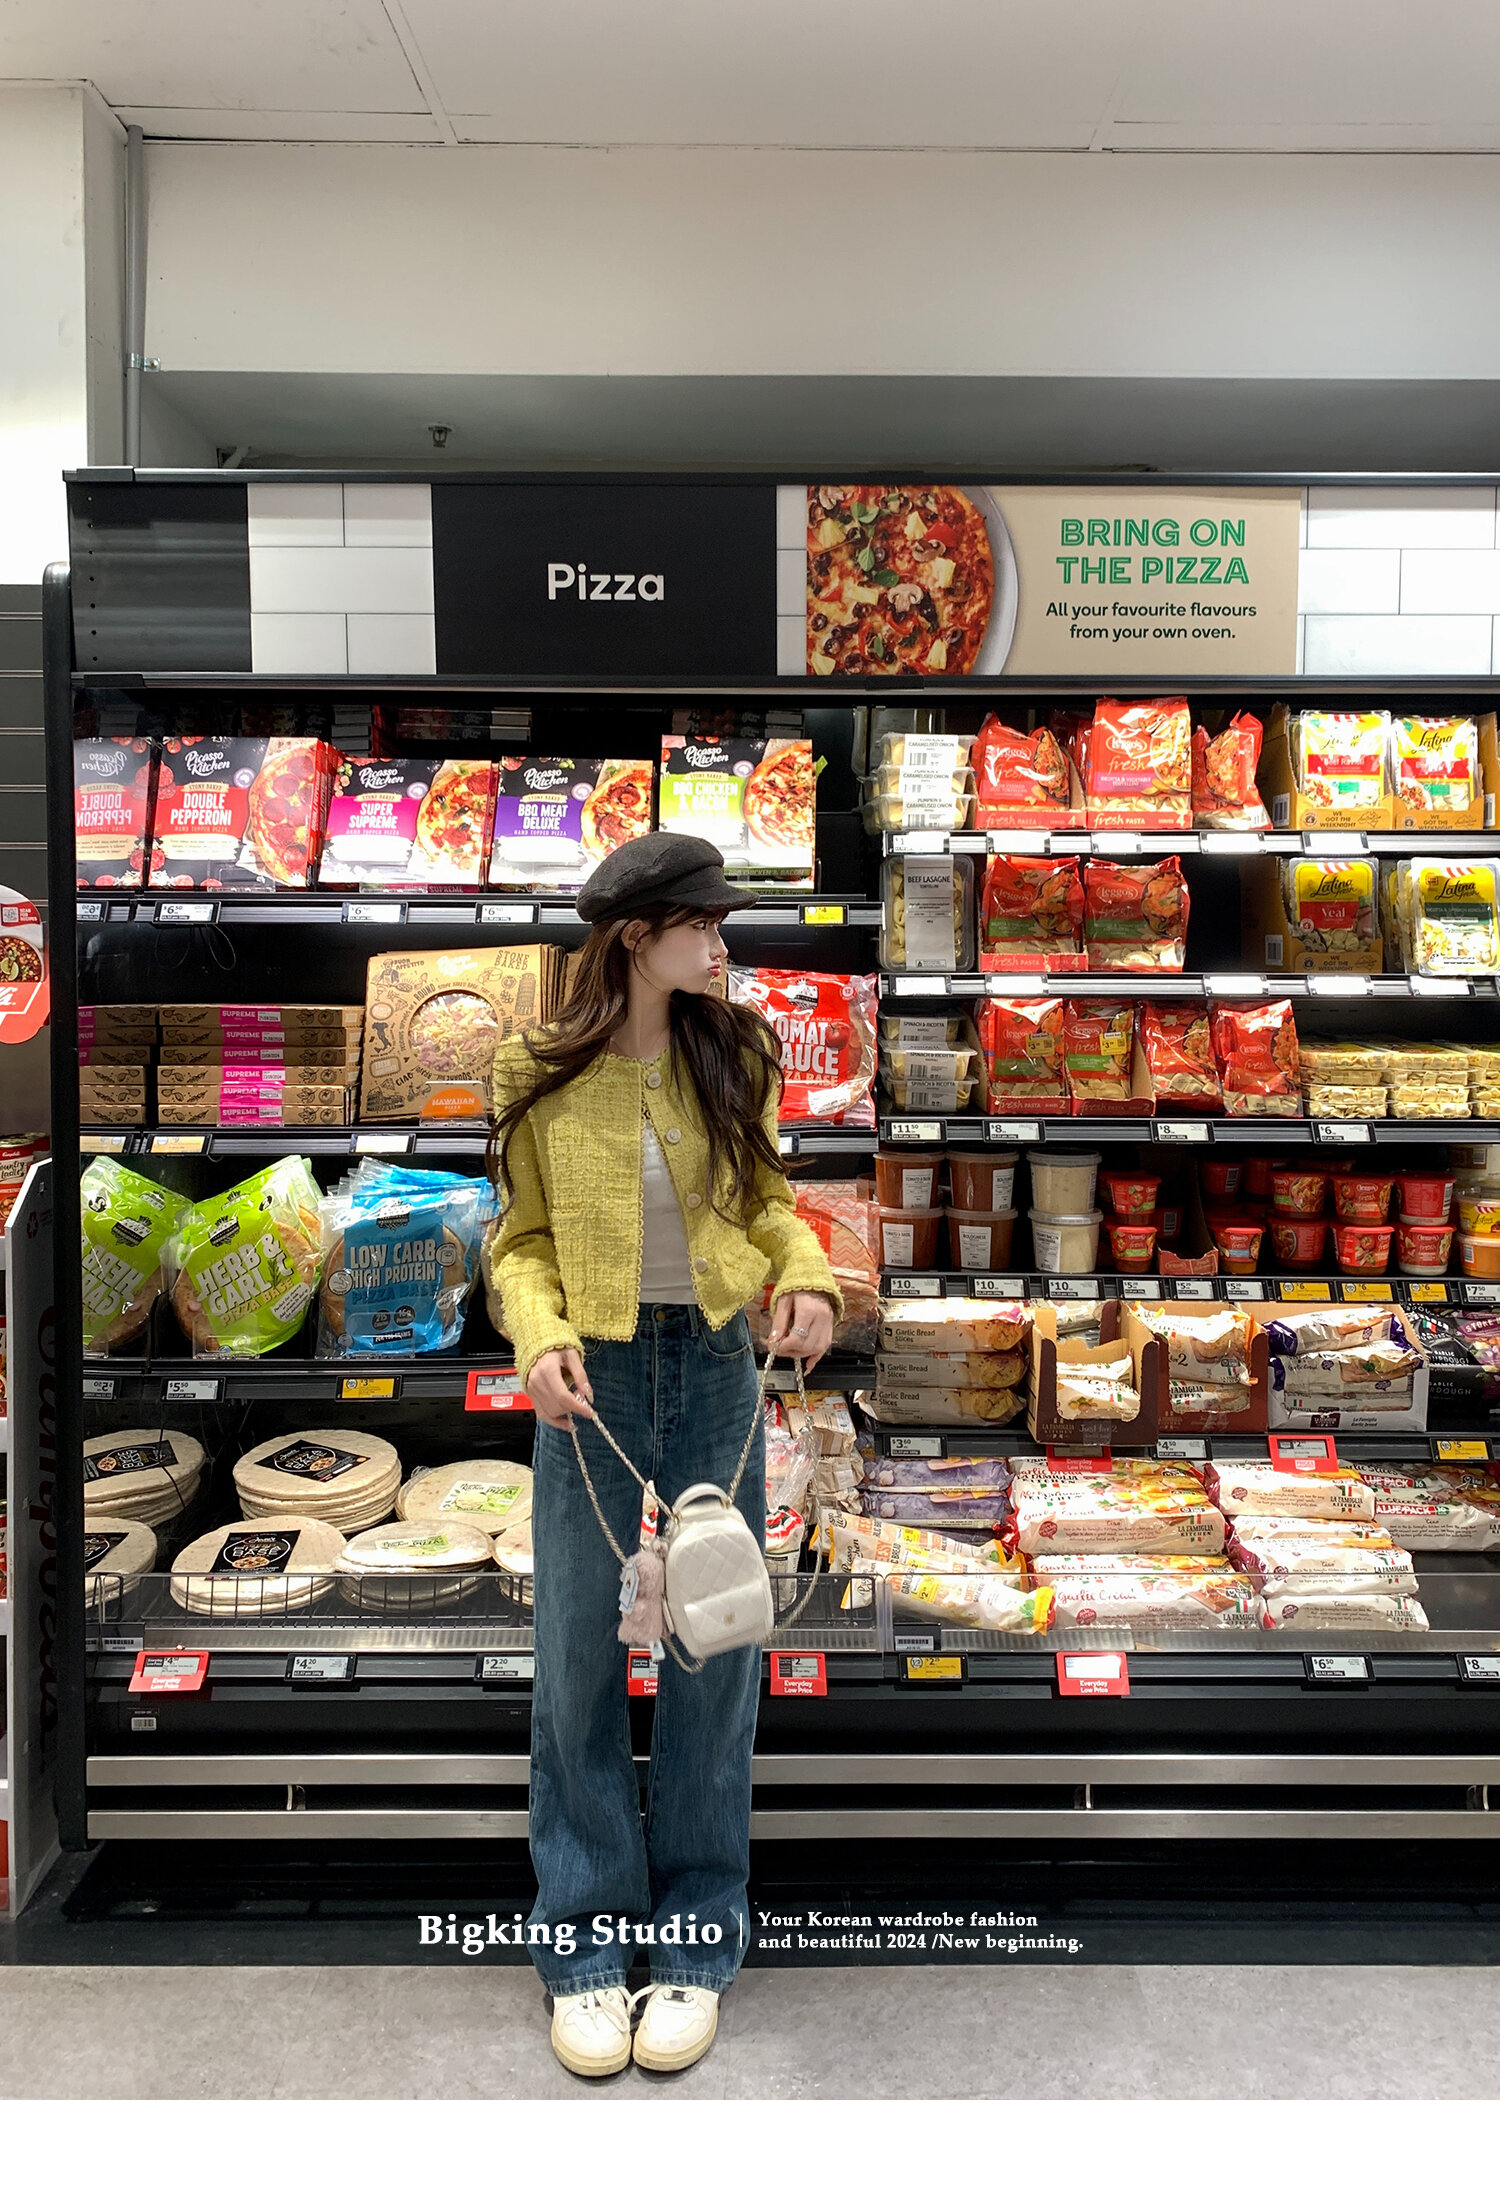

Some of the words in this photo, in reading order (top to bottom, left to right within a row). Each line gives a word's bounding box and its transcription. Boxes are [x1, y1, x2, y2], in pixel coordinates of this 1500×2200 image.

[1060, 518, 1180, 547] BRING
[1189, 518, 1246, 547] ON
[1055, 557, 1132, 585] THE
[1141, 557, 1251, 585] PIZZA
[547, 563, 664, 601] Pizza
[1046, 602, 1068, 617] All
[1071, 606, 1109, 621] your
[1111, 602, 1187, 617] favourite
[1191, 602, 1257, 617] flavours
[1069, 624, 1109, 639] from
[1112, 627, 1150, 643] your
[1152, 628, 1188, 639] own
[1191, 628, 1236, 639] oven.
[185, 750, 223, 768] Picasso
[684, 745, 722, 760] Picasso
[688, 753, 729, 767] Kitchen
[1108, 756, 1147, 776] fresh
[188, 759, 230, 776] Kitchen
[359, 767, 398, 782] Picasso
[363, 775, 404, 789] Kitchen
[524, 768, 562, 782] Picasso
[528, 775, 568, 790] Kitchen
[695, 782, 738, 796] CHICKEN
[183, 793, 226, 809] DOUBLE
[360, 803, 393, 816] SUPER
[518, 804, 539, 817] BBQ
[541, 804, 568, 818] MEAT
[170, 809, 231, 826] PEPPERONI
[349, 815, 398, 829] SUPREME
[523, 817, 560, 830] DELUXE
[986, 814, 1016, 827] fresh
[1068, 815, 1076, 826] 4
[1094, 813, 1124, 828] fresh
[1125, 817, 1145, 825] PASTA
[1175, 813, 1185, 827] 4
[923, 876, 950, 884] LASAGNE
[1310, 874, 1353, 897] Latina
[1434, 880, 1475, 900] Latina
[1321, 907, 1346, 918] Veal
[497, 950, 530, 961] STONE
[989, 954, 1019, 969] fresh
[494, 957, 528, 970] BAKED
[414, 983, 436, 1001] ROUND
[222, 1010, 255, 1018] SUPREME
[780, 1042, 839, 1075] AUCE
[223, 1087, 258, 1095] SUPREME
[432, 1097, 475, 1106] HAWAIIAN
[350, 1244, 387, 1269] LOW
[392, 1239, 438, 1264] CARB
[195, 1243, 262, 1297] HERB
[260, 1233, 282, 1265] &
[351, 1267, 381, 1289] HIGH
[384, 1261, 436, 1285] PROTEIN
[221, 1299, 262, 1328] PIZZA
[261, 1278, 294, 1304] BASE
[895, 1328, 915, 1336] Garlic
[917, 1329, 936, 1337] Bread
[887, 1364, 907, 1372] Garlic
[878, 1391, 898, 1399] Garlic
[900, 1392, 919, 1400] Bread
[1066, 1458, 1092, 1466] Everyday
[1339, 1496, 1363, 1504] FAMIGLIA
[1185, 1525, 1214, 1533] FAMIGLIA
[152, 1677, 181, 1687] Everyday
[164, 1682, 179, 1690] Price
[784, 1680, 813, 1689] Everyday
[1080, 1680, 1108, 1689] Everyday
